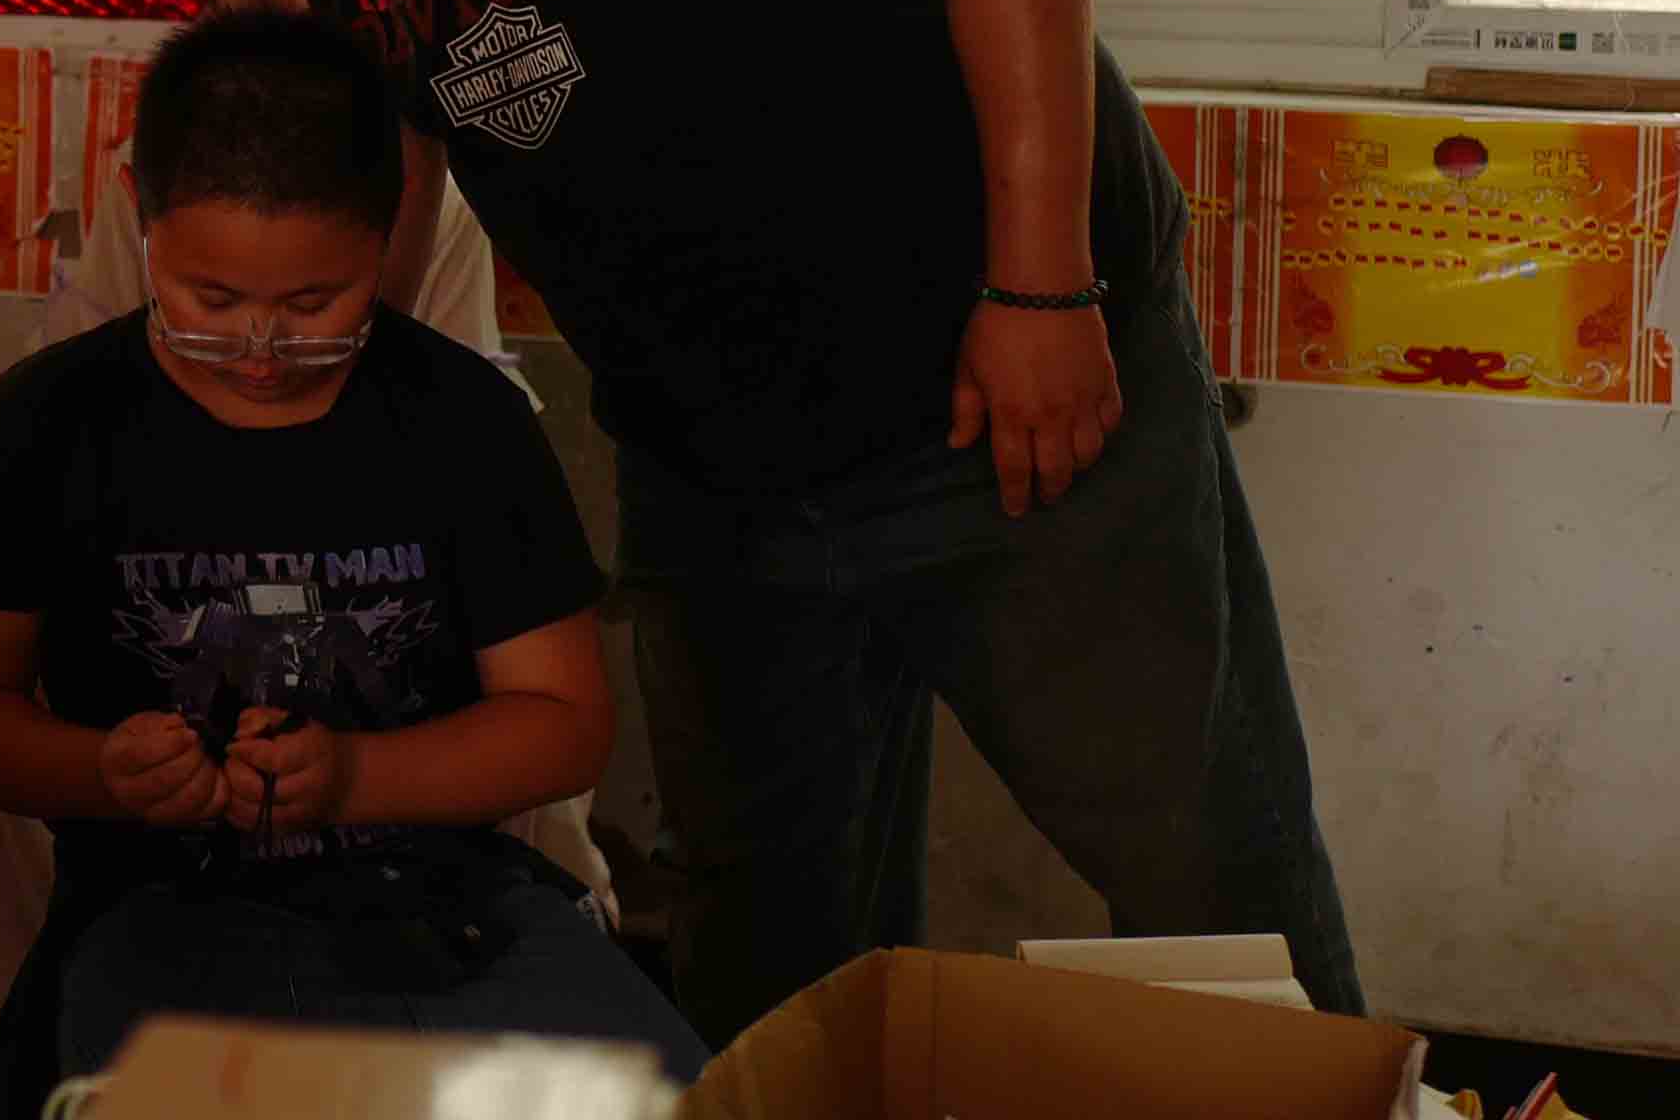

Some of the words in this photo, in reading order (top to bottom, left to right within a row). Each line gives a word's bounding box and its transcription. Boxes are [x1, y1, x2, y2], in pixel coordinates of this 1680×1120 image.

[471, 20, 529, 63] MOTOR
[450, 41, 570, 109] HARLEY-DAVIDSON
[495, 88, 552, 134] CYCLES
[113, 551, 248, 591] TITAN
[256, 551, 316, 582] TV
[322, 543, 427, 589] MAN
